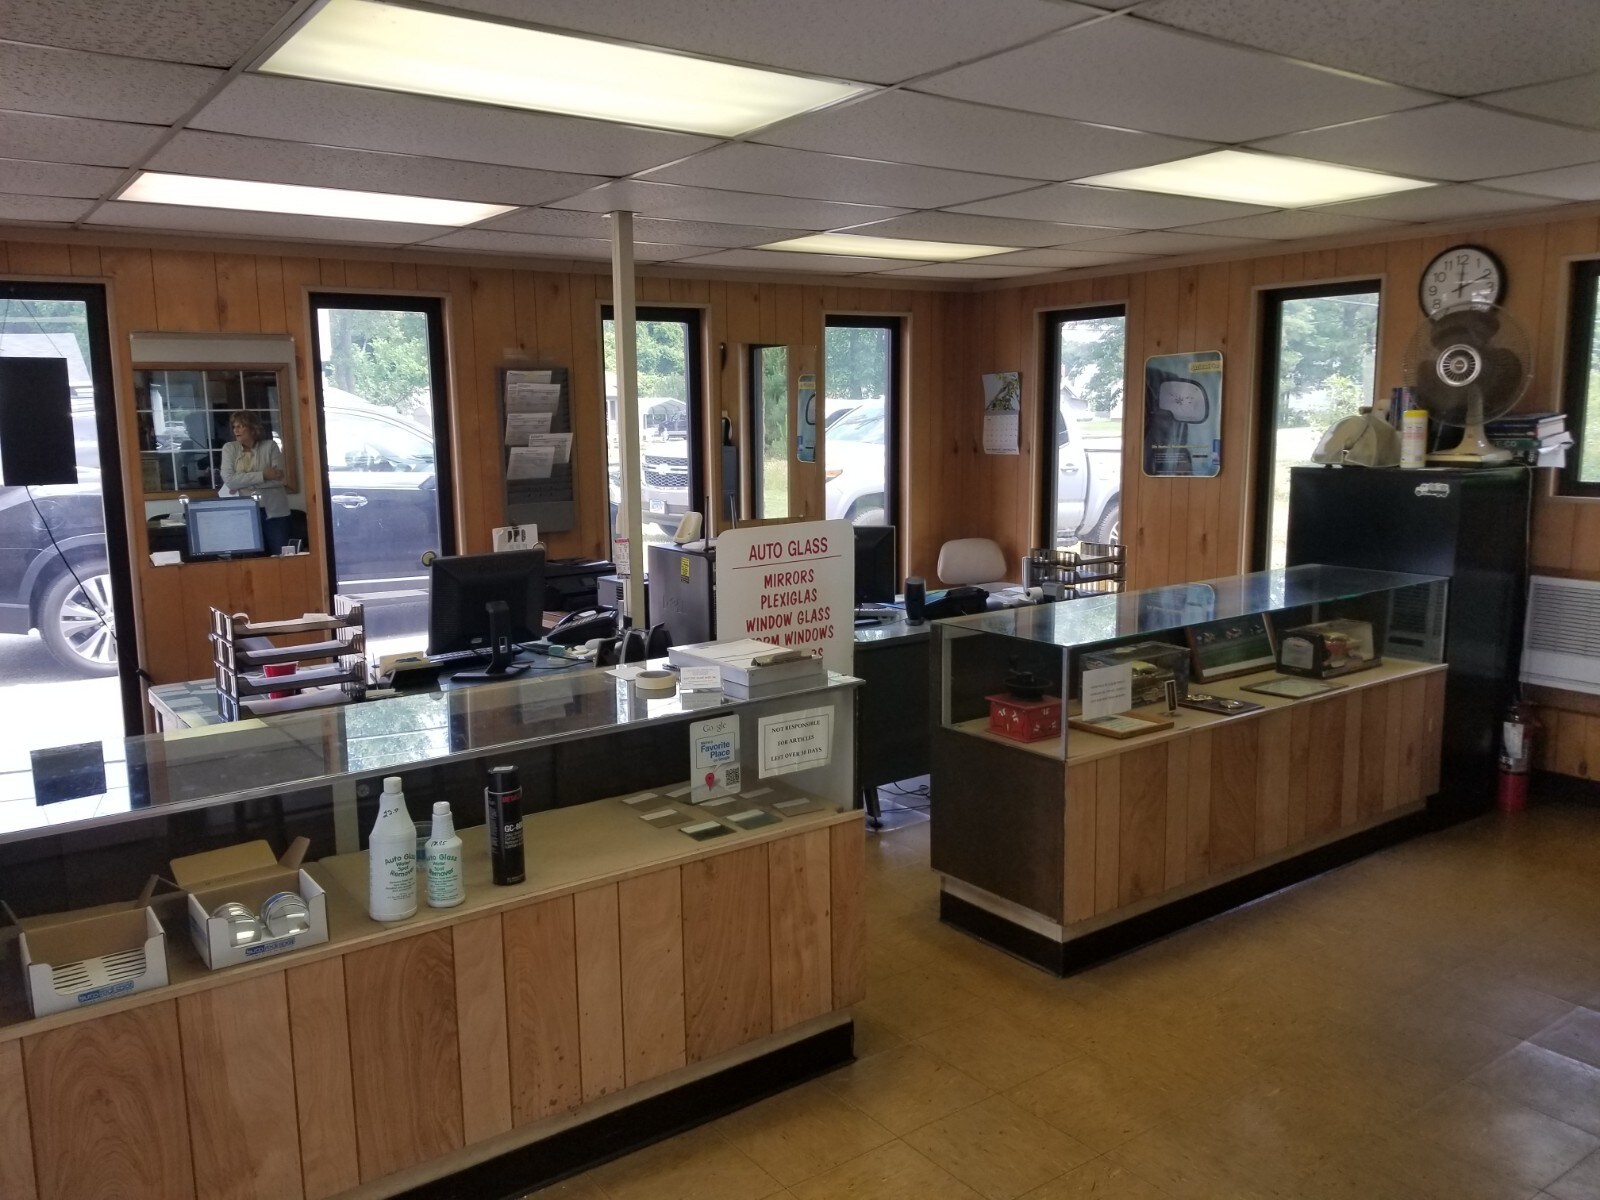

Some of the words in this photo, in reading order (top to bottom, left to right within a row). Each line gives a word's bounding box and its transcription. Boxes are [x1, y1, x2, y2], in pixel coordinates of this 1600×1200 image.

[1444, 261, 1453, 271] 11
[1456, 254, 1469, 266] 12
[1476, 258, 1480, 268] 1
[1433, 272, 1446, 283] 10
[1428, 285, 1438, 296] 9
[1433, 298, 1441, 309] 8
[748, 541, 783, 561] AUTO
[787, 536, 828, 557] GLASS
[763, 568, 815, 589] MIRRORS
[760, 587, 818, 610] PLEXIGLAS
[745, 611, 793, 633] WINDOW
[796, 606, 831, 625] GLASS
[784, 624, 834, 646] WINDOWS
[702, 721, 727, 733] Gogle
[771, 726, 785, 734] NOT
[785, 719, 821, 731] RESPONSIBLE
[777, 738, 789, 747] FOR
[789, 734, 815, 744] ARTICLES
[700, 741, 731, 753] Favorite
[784, 751, 800, 759] OVER
[807, 746, 823, 755] DAYS
[710, 749, 731, 759] Place
[384, 855, 402, 865] Auto
[438, 853, 458, 862] Glass
